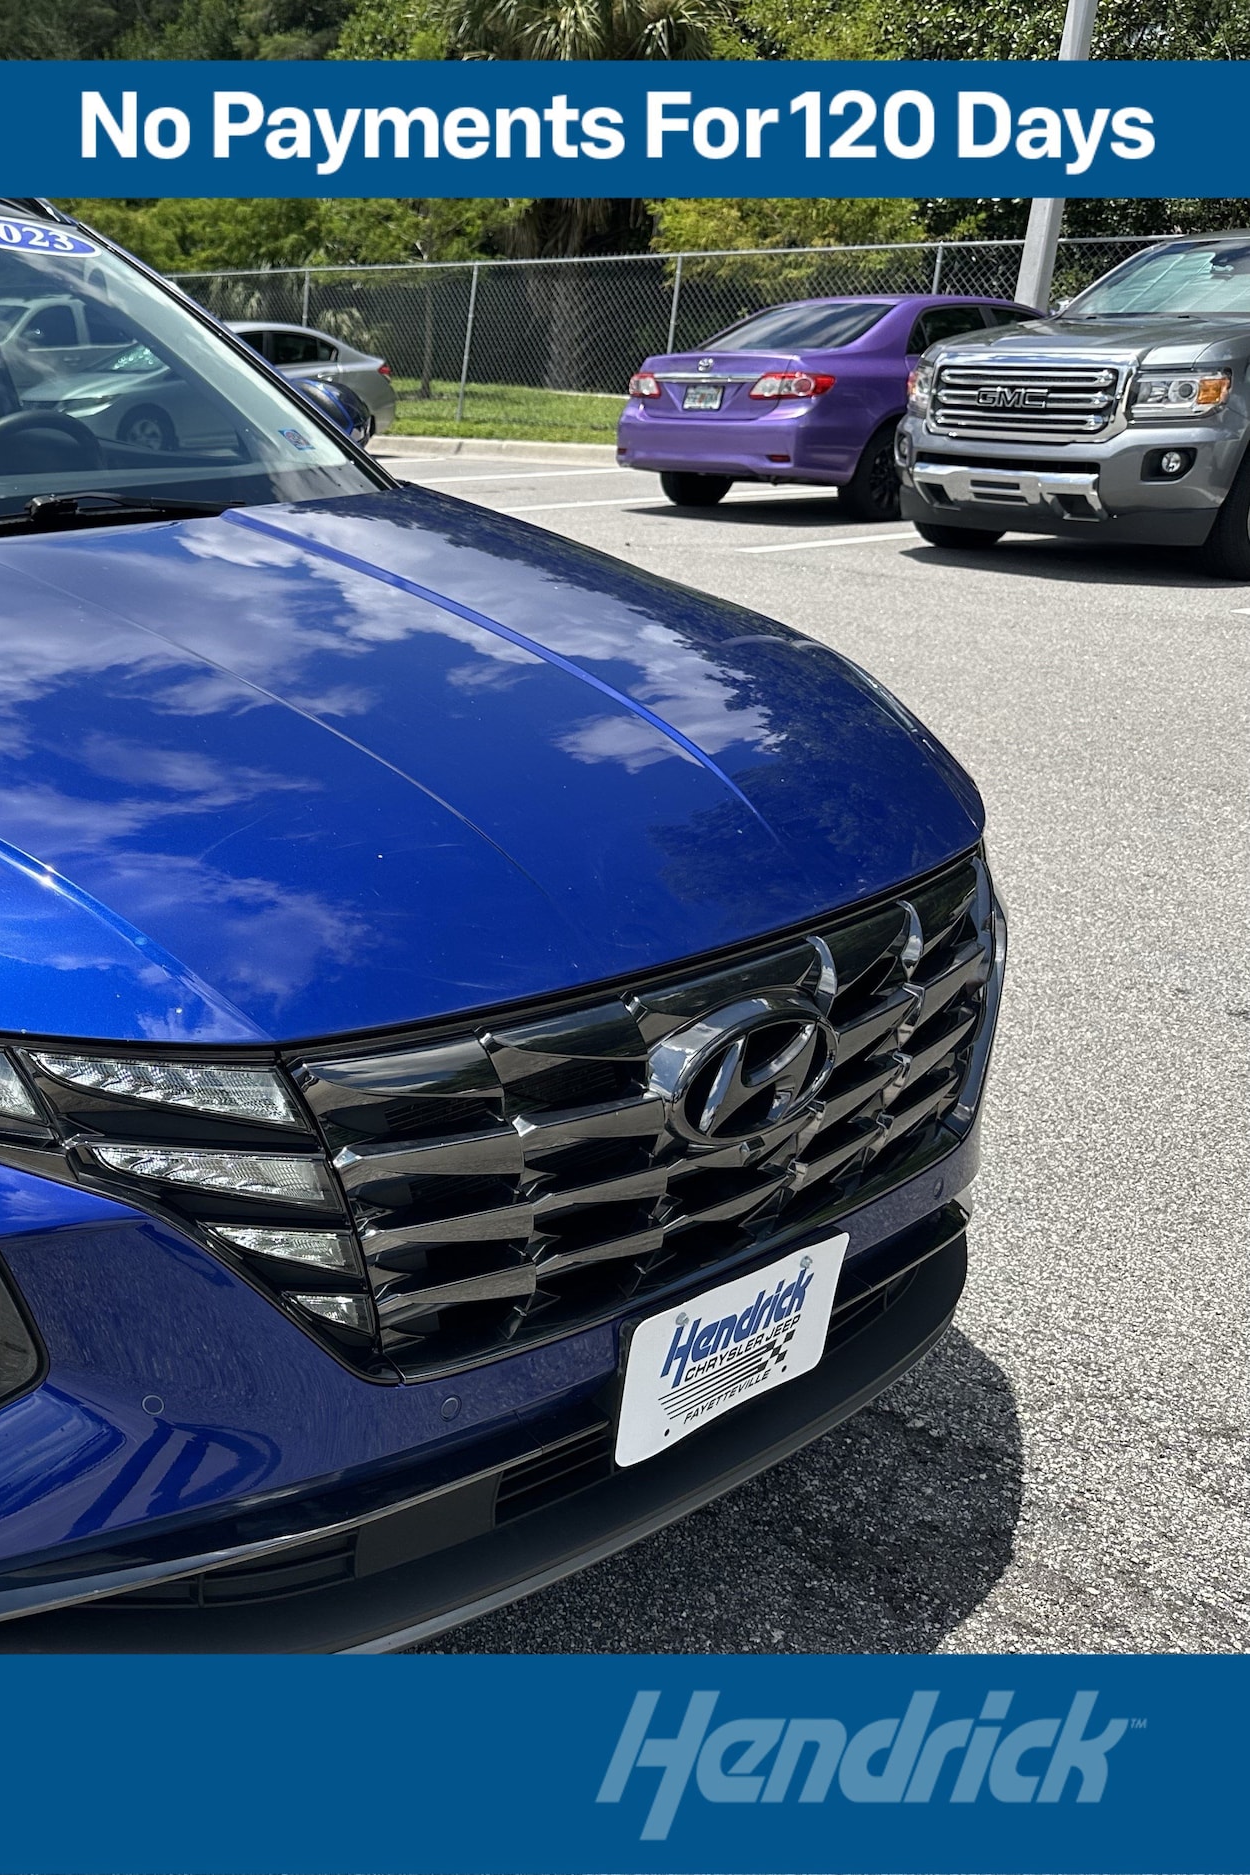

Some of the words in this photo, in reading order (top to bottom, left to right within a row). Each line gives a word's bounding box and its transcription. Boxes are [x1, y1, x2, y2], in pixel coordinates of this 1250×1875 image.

[976, 386, 1049, 409] GMC
[660, 1268, 815, 1389] Hendrick
[684, 1333, 764, 1382] CHRYSLER
[765, 1314, 801, 1341] JEEP
[684, 1368, 771, 1424] FAYETTEVILLE
